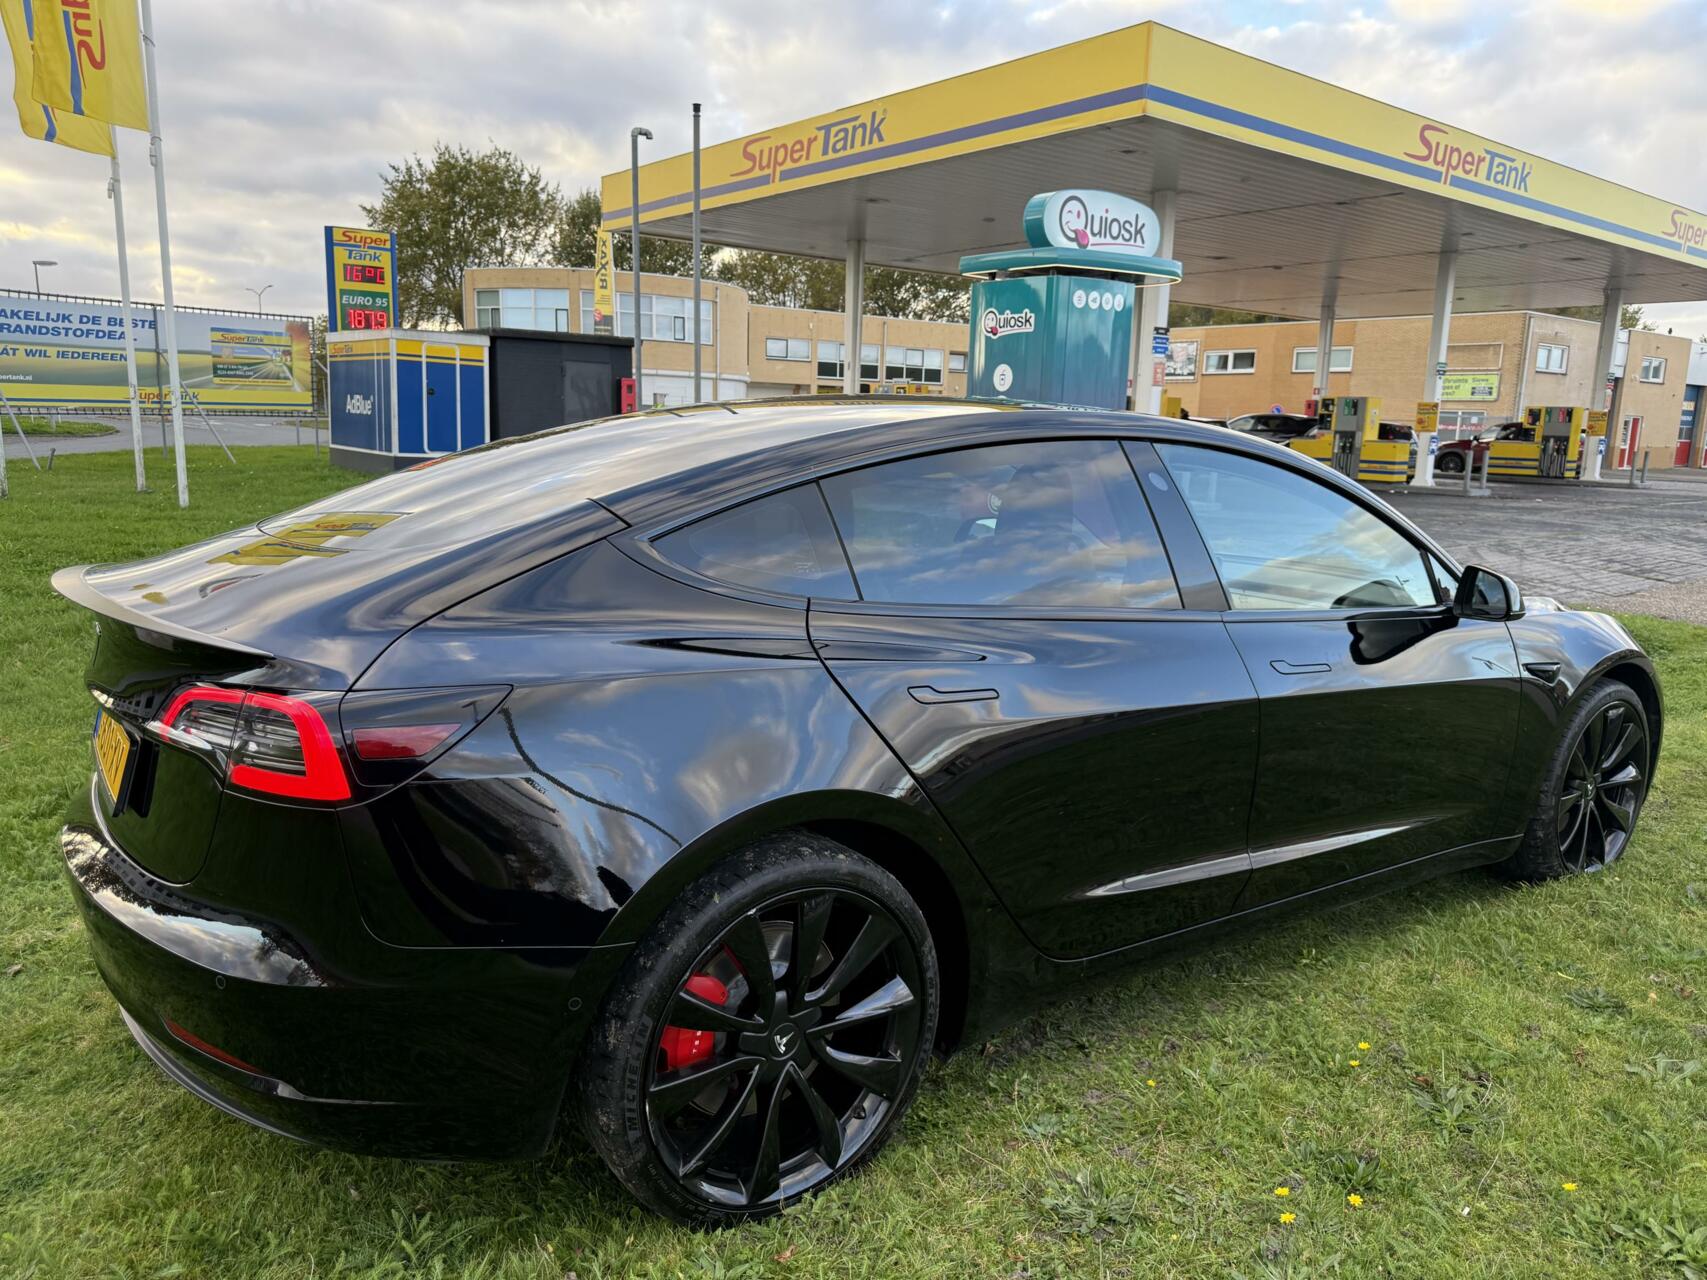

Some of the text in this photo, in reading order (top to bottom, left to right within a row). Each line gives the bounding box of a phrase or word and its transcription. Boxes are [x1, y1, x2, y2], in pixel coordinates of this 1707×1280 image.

[1059, 195, 1145, 247] Quiosk
[335, 230, 389, 249] Super
[344, 248, 382, 262] Tank
[341, 295, 388, 307] EURO 95
[79, 315, 103, 326] DE
[985, 311, 1032, 334] Quiosk
[0, 322, 138, 342] RANDSTOFDEA.
[24, 348, 51, 359] WIL
[57, 350, 128, 362] IEDEREEN
[346, 394, 372, 415] AdBlue
